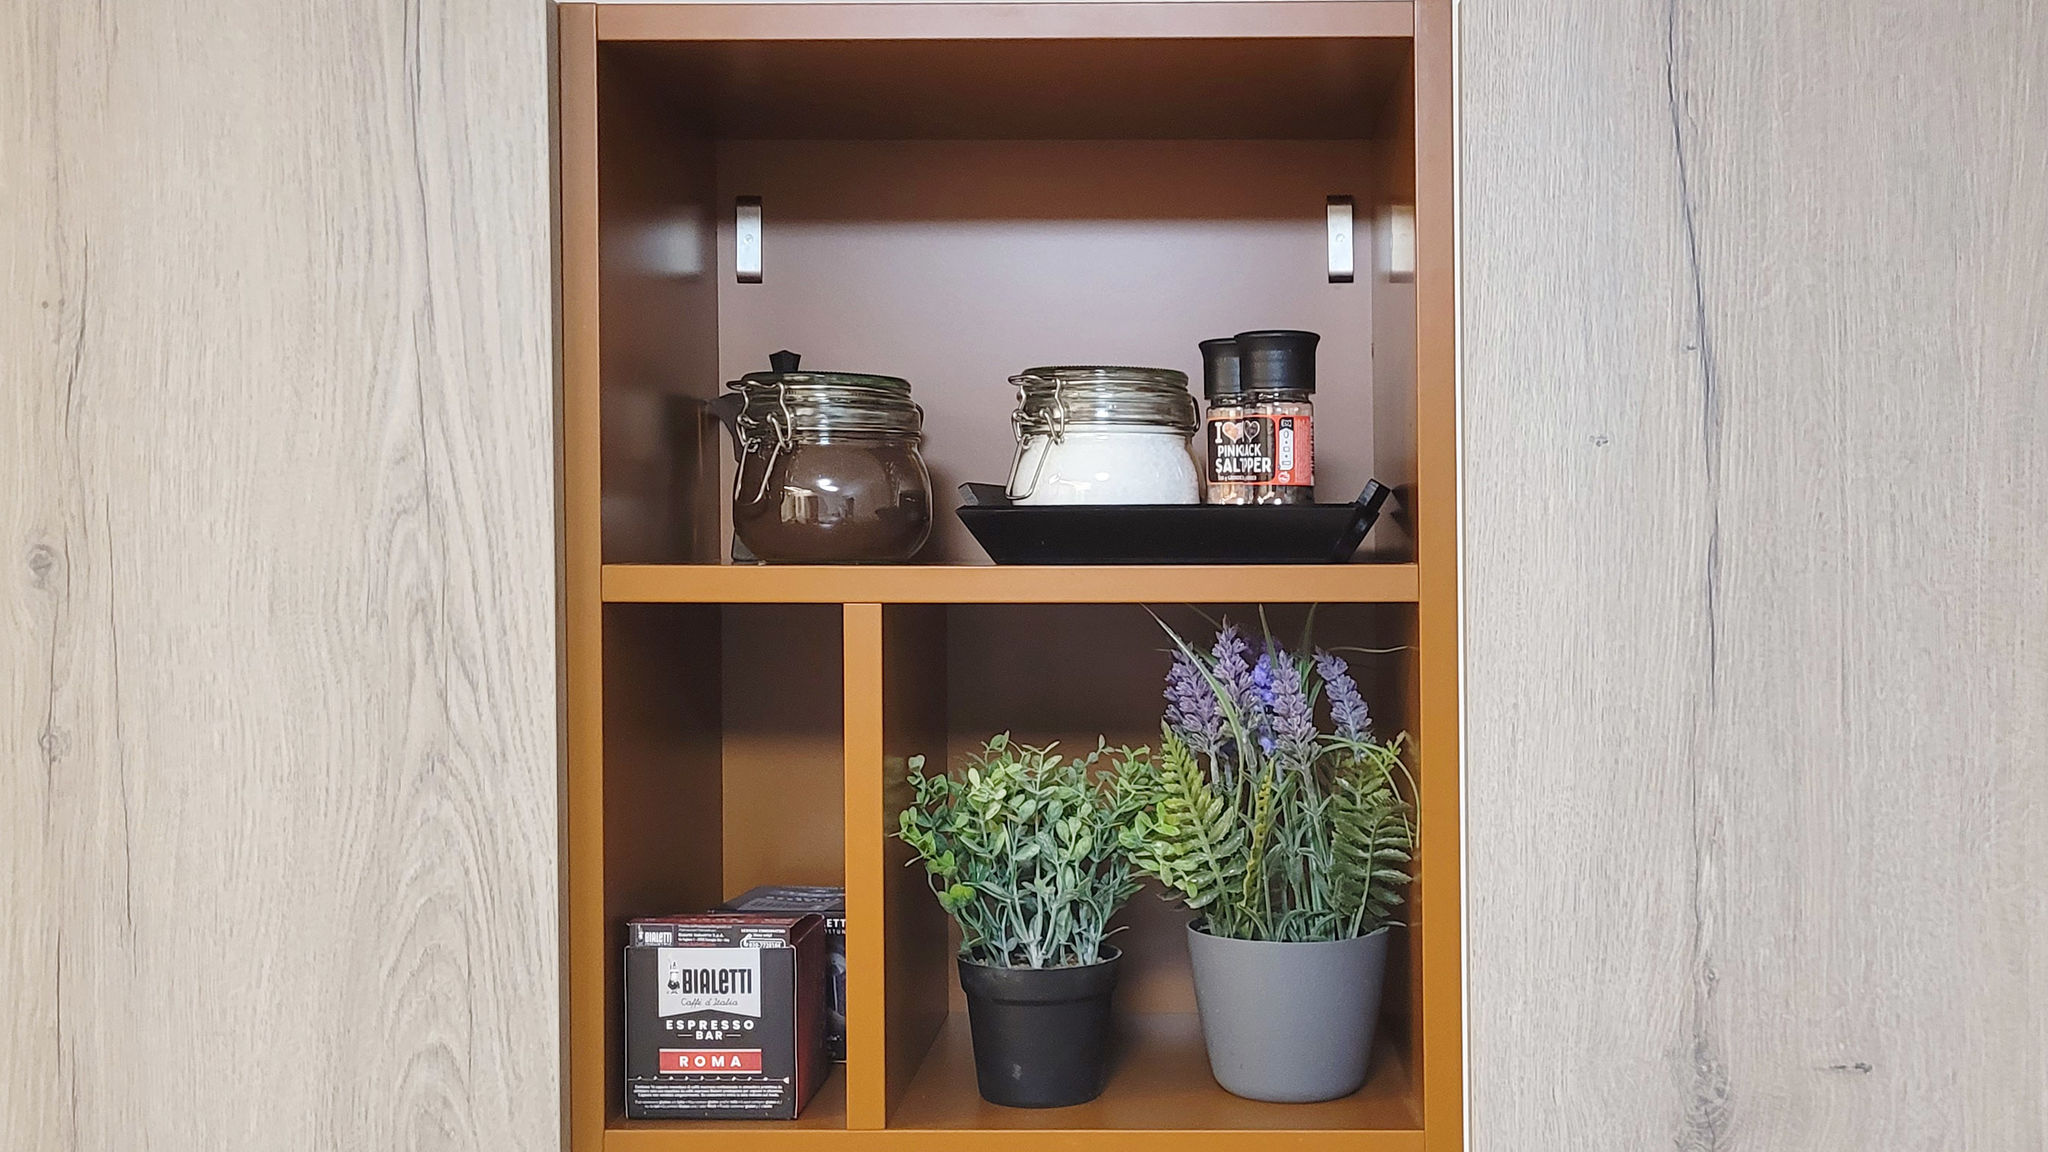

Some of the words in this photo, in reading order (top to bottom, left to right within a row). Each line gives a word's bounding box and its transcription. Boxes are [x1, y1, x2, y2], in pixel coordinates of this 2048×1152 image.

[1215, 422, 1223, 443] I
[682, 968, 752, 994] BIALETTI
[665, 1019, 755, 1031] ESPRESSO
[695, 1030, 723, 1041] BAR
[679, 1055, 742, 1068] ROMA
